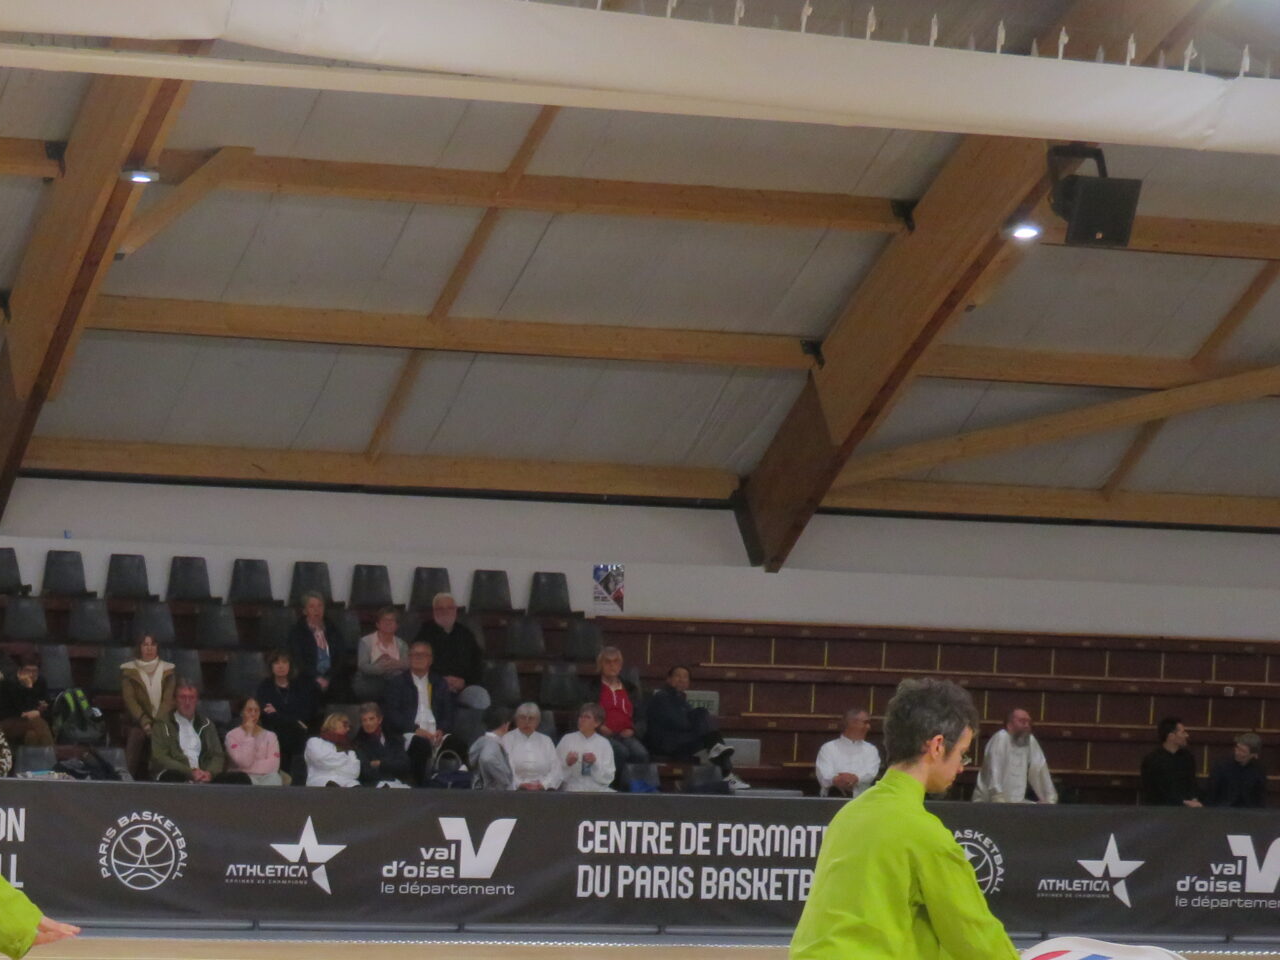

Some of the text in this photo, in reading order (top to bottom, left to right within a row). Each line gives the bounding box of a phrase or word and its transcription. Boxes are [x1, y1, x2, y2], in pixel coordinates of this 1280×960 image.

[98, 810, 189, 881] PARIS BASKETBALL
[578, 821, 674, 854] CENTRE
[680, 823, 711, 855] DE
[420, 844, 456, 863] val
[954, 829, 1005, 895] ASKETBALL
[225, 864, 309, 878] ATHLETICA
[1211, 860, 1242, 875] val
[381, 881, 514, 896] le département
[577, 865, 610, 897] DU
[618, 865, 694, 898] PARIS
[1037, 880, 1111, 893] ATHLETICA
[1175, 896, 1188, 908] le
